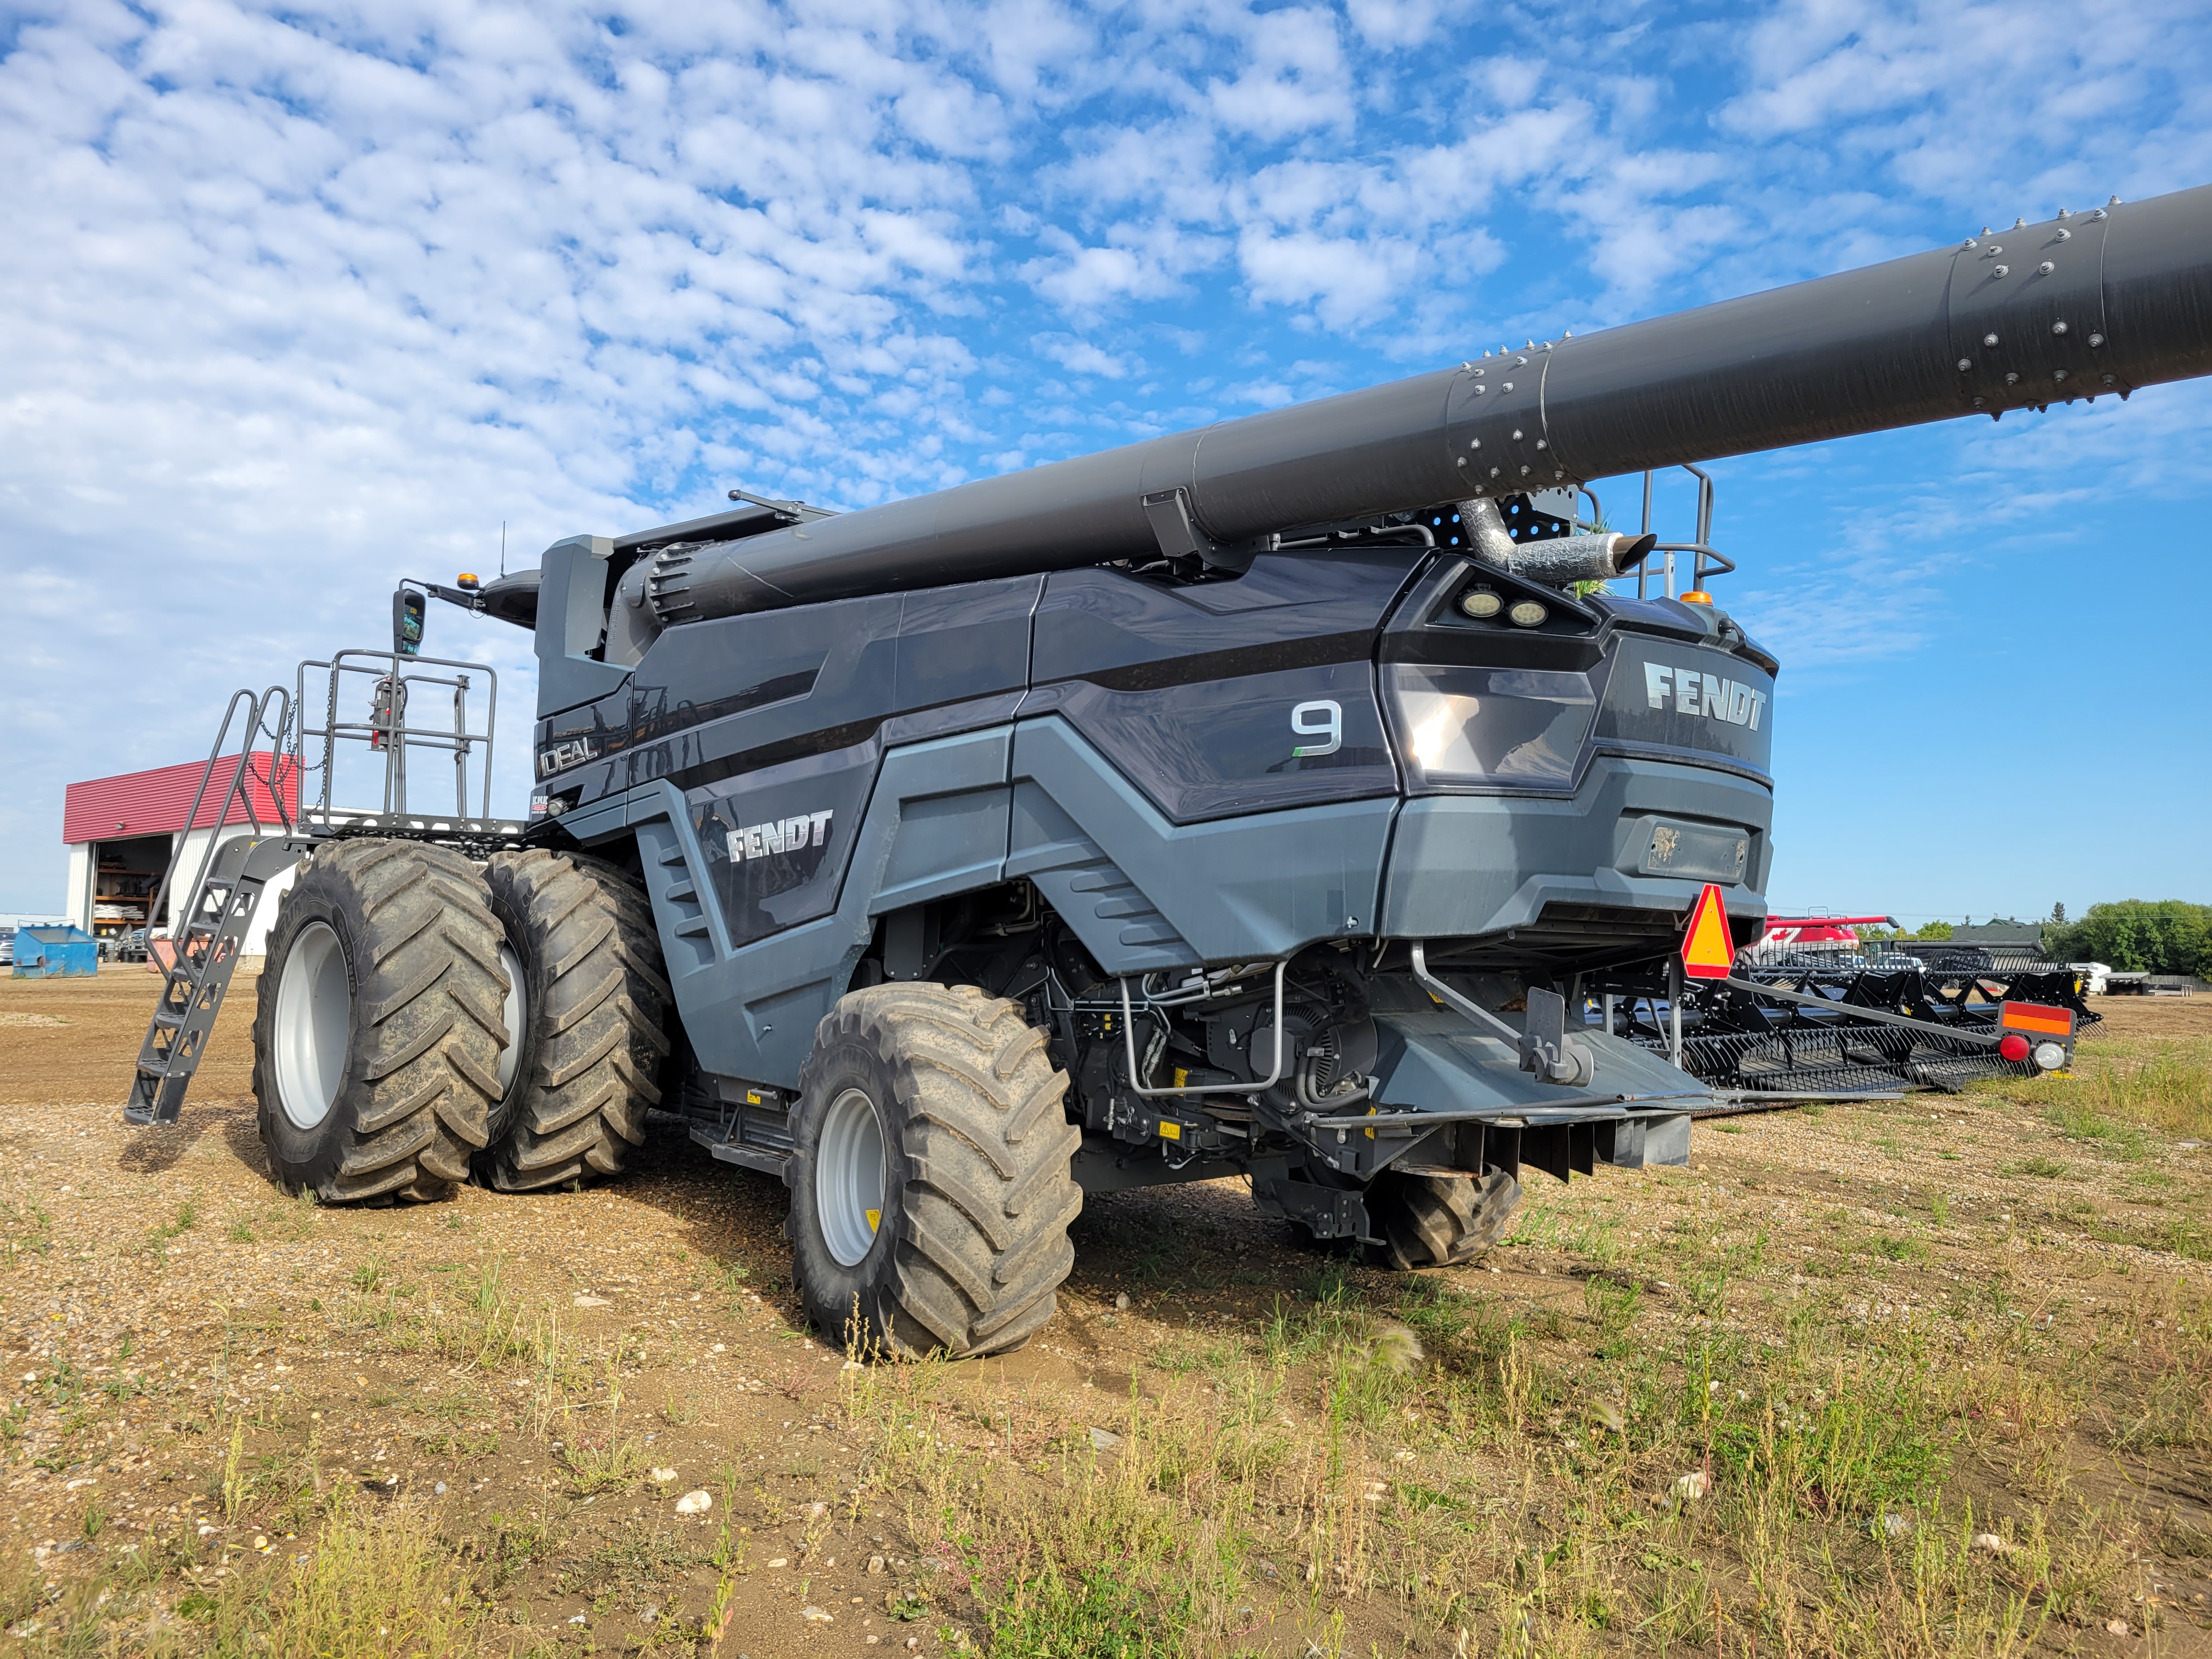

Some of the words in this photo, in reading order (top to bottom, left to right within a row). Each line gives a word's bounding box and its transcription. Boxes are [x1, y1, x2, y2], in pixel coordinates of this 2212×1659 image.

[1644, 662, 1767, 732] FENDT
[1292, 699, 1342, 757] 9
[540, 737, 598, 777] IDEAL
[726, 809, 834, 864] FENDT
